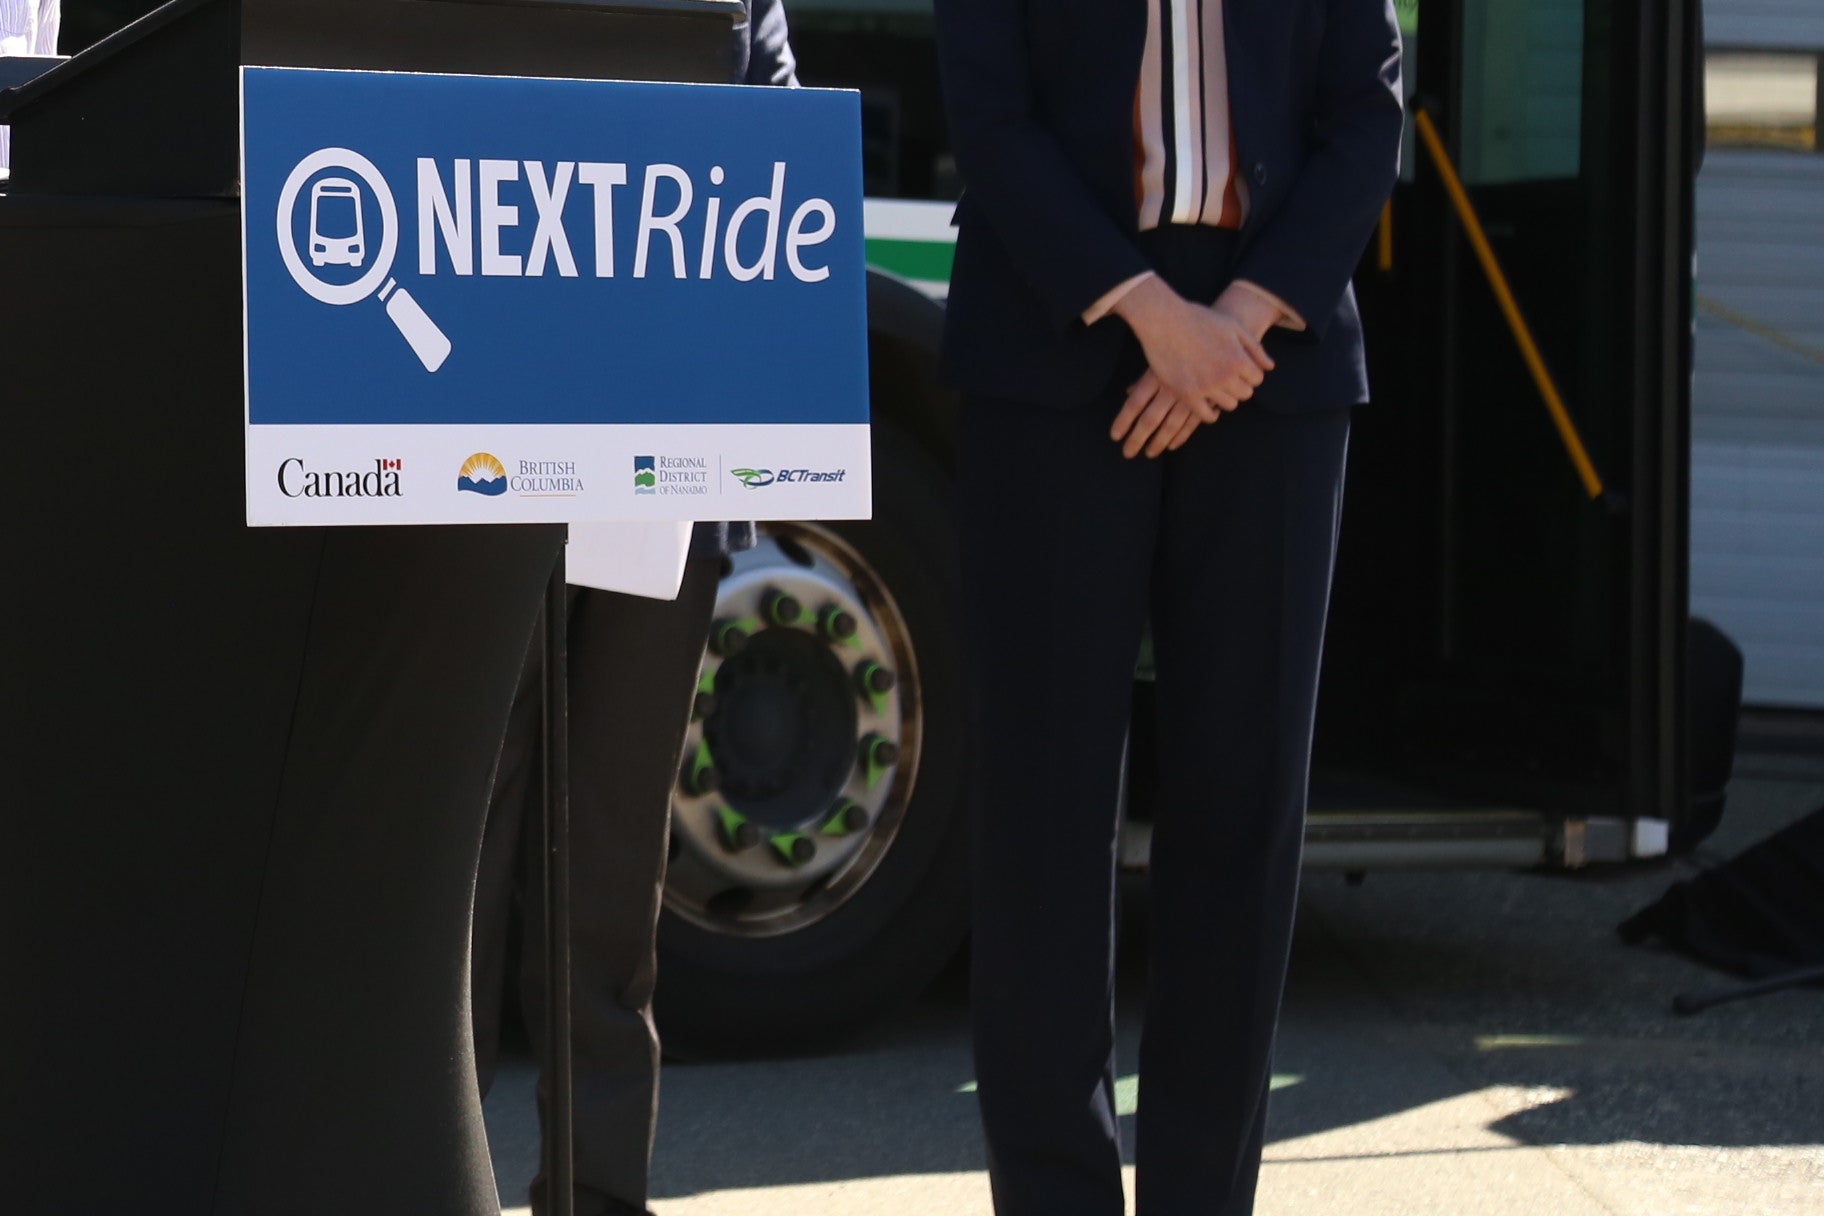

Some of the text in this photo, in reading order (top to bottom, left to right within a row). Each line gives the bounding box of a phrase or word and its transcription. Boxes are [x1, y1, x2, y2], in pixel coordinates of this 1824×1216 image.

[518, 459, 576, 476] BRITISH
[659, 455, 707, 468] REGIONAL
[277, 457, 404, 498] Canada
[659, 470, 708, 483] DISTRICT
[776, 468, 846, 483] BCTransit
[510, 476, 585, 492] COLUMBIA
